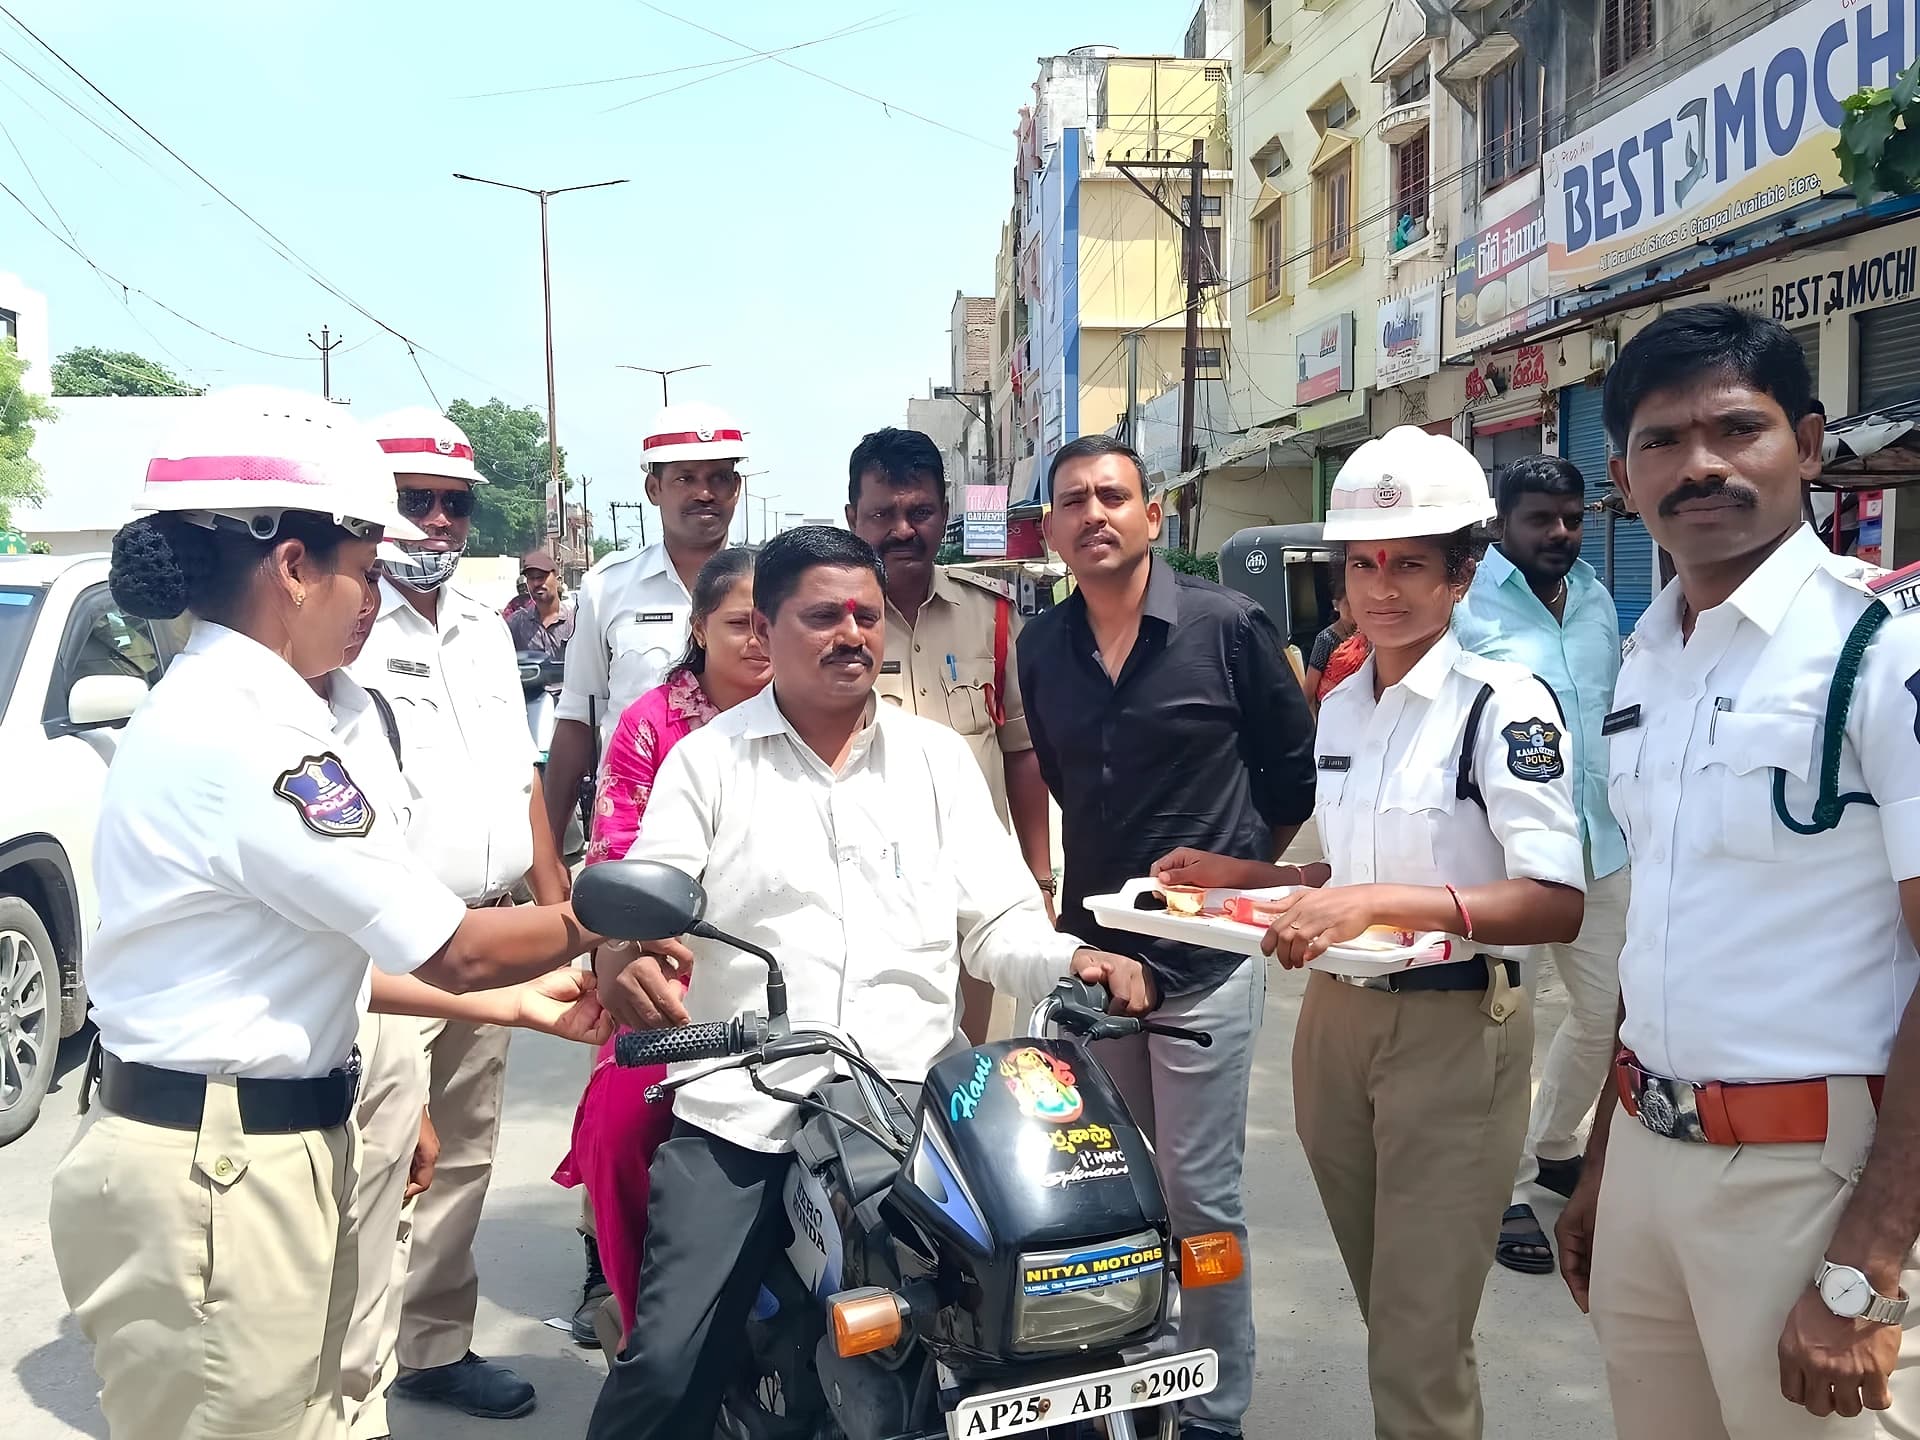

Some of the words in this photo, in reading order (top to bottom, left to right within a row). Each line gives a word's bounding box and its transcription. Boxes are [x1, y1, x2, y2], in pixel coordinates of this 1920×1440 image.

[1563, 118, 1674, 255] BEST
[1647, 230, 1678, 254] Shoes
[1690, 203, 1731, 238] Chappal
[1733, 184, 1786, 220] Available
[1772, 274, 1824, 322] BEST
[1846, 246, 1917, 308] MOCHI
[951, 1052, 993, 1121] Hani
[1026, 1263, 1089, 1283] NITYA
[1093, 1247, 1163, 1273] MOTORS
[966, 1396, 1041, 1437] AP25
[1071, 1384, 1113, 1415] AB
[1146, 1362, 1205, 1400] 2906
